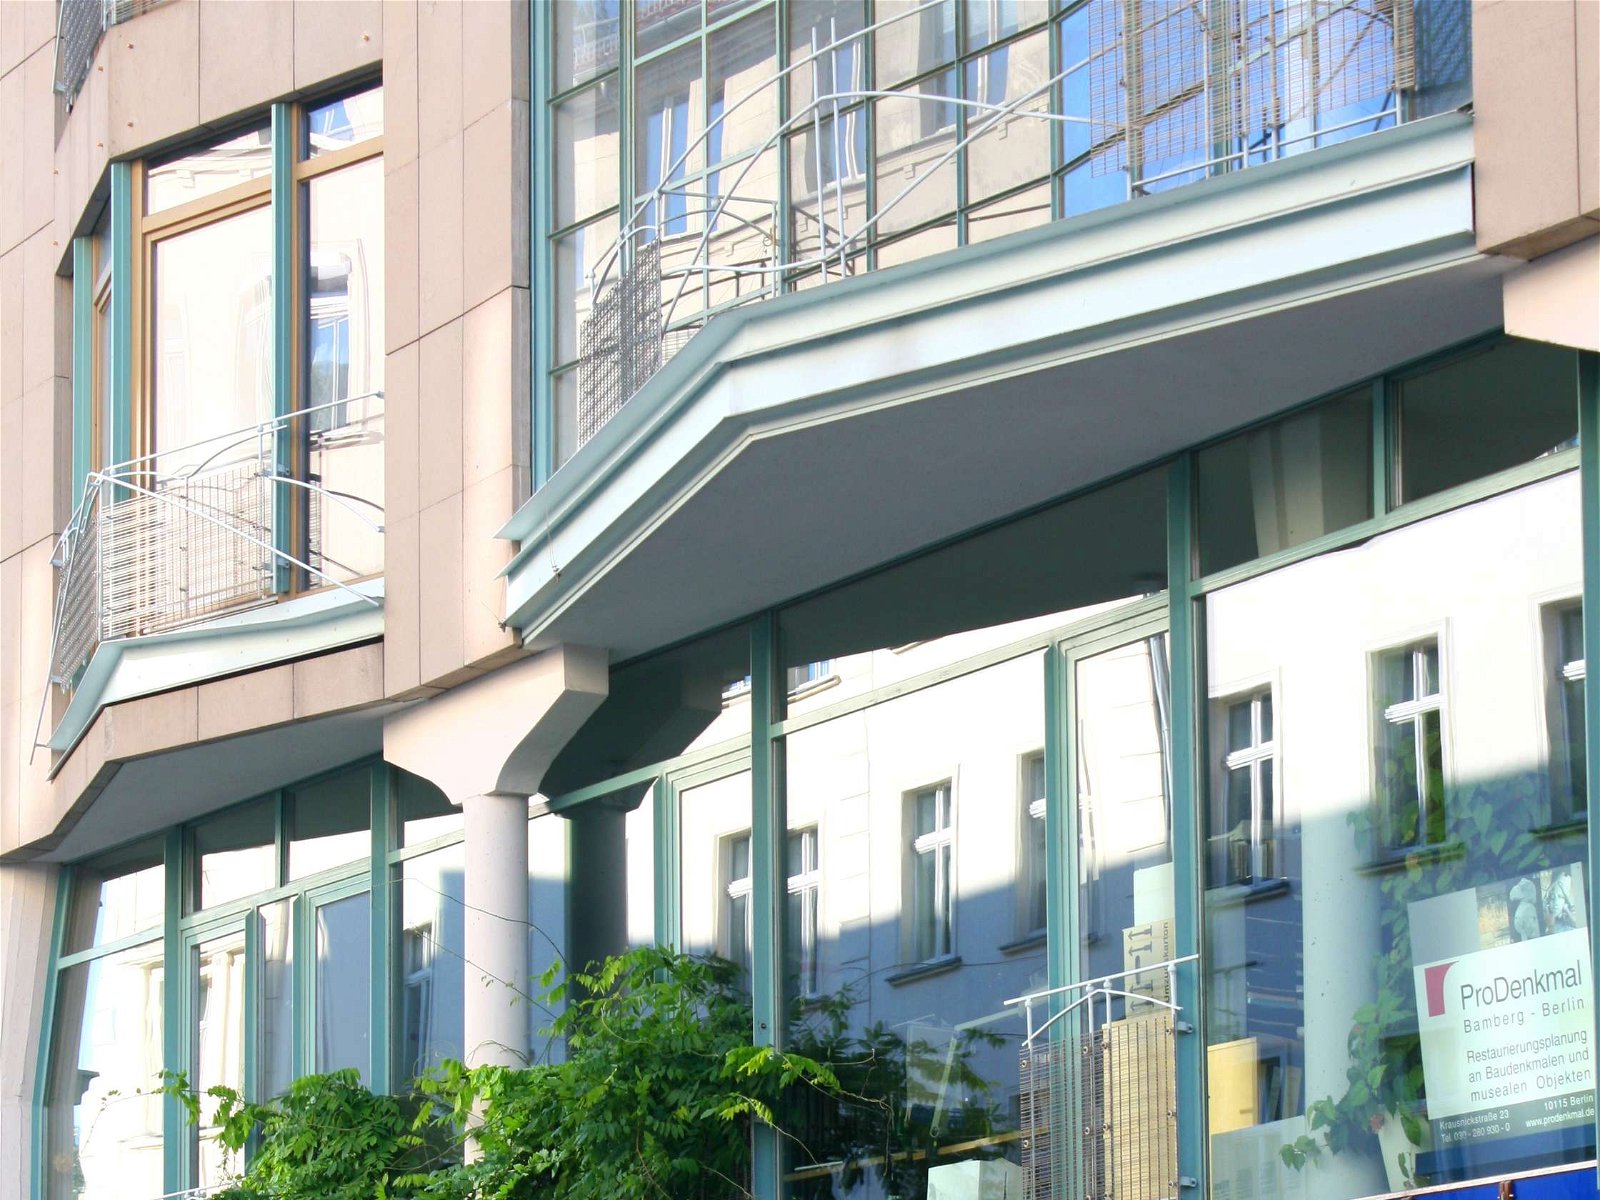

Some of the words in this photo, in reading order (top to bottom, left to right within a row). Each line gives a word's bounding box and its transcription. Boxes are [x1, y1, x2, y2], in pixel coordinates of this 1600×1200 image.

[1460, 960, 1582, 1011] ProDenkmal
[1464, 1011, 1524, 1033] Bamberg
[1542, 997, 1585, 1017] Berlin
[1467, 1030, 1588, 1063] Restaurierungsplanung
[1468, 1071, 1482, 1083] an
[1485, 1055, 1566, 1079] Baudenkmalen
[1568, 1047, 1589, 1063] und
[1471, 1081, 1527, 1102] musealen
[1536, 1068, 1591, 1091] Objekten
[1499, 1109, 1510, 1120] 23
[1525, 1107, 1595, 1128] www.prodenkmal.de
[1544, 1099, 1567, 1111] 10115
[1570, 1093, 1594, 1106] Berlin
